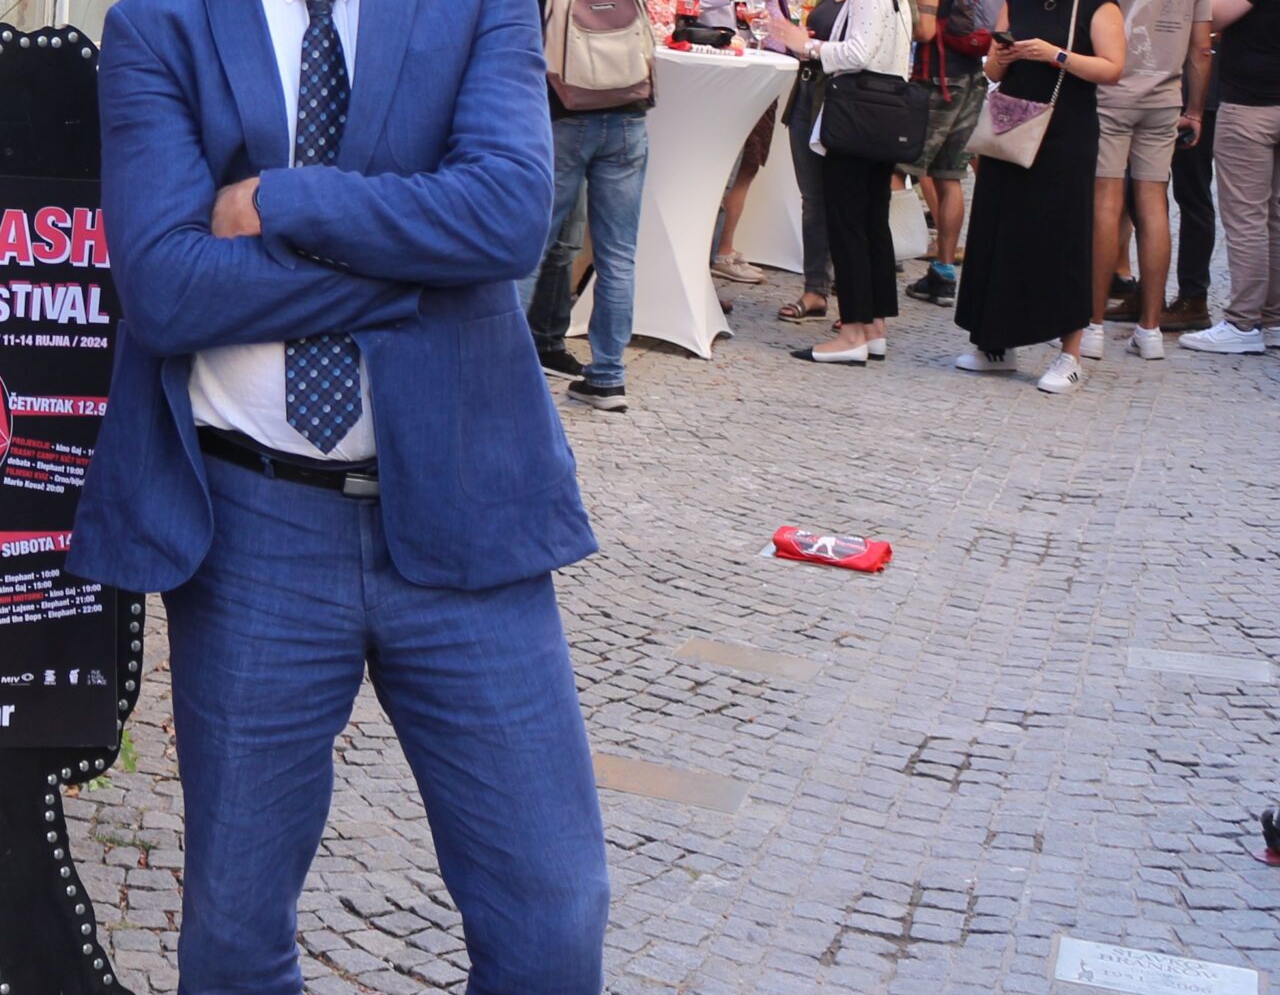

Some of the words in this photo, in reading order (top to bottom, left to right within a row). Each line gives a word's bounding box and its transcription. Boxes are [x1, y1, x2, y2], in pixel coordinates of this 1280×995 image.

[2, 334, 33, 346] 11-14
[35, 336, 70, 347] RUJNA
[80, 336, 108, 348] 2024
[8, 392, 74, 414] ČETVRTAK
[8, 456, 30, 468] debata
[36, 460, 65, 472] Elephant
[46, 483, 64, 494] 20:00
[2, 537, 54, 558] SUBOTA
[4, 572, 34, 584] Elephant
[15, 583, 26, 593] Gaj
[50, 589, 65, 598] kino
[41, 598, 70, 610] Elephant
[75, 594, 95, 604] 21:00
[12, 613, 24, 623] the
[48, 608, 76, 619] Elephant
[82, 604, 102, 614] 22:00
